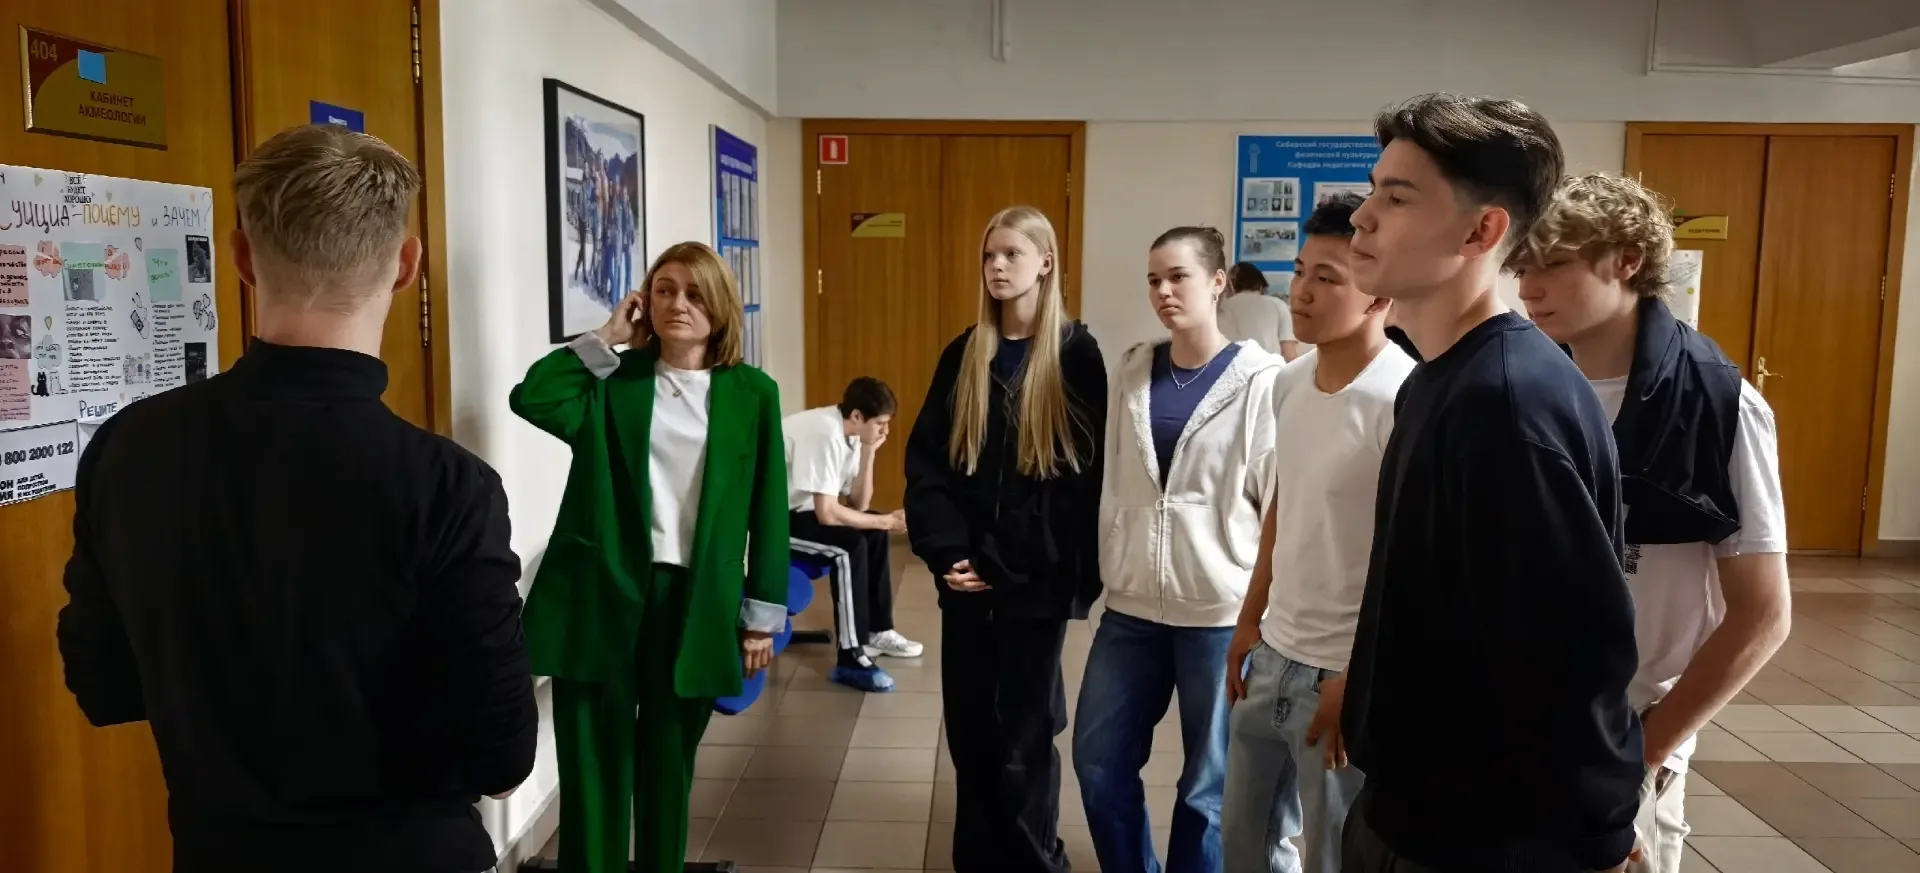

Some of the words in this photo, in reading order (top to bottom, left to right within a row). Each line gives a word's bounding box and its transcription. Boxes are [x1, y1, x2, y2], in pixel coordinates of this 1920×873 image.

[31, 39, 57, 61] 404
[90, 90, 134, 107] КАБИНЕТ
[79, 104, 146, 126] АКМЕОЛОГИИ
[64, 195, 92, 204] ХОРОШО
[67, 186, 86, 195] БУДЕТ
[4, 449, 27, 466] 800
[28, 444, 54, 461] 2000
[56, 440, 74, 456] 122
